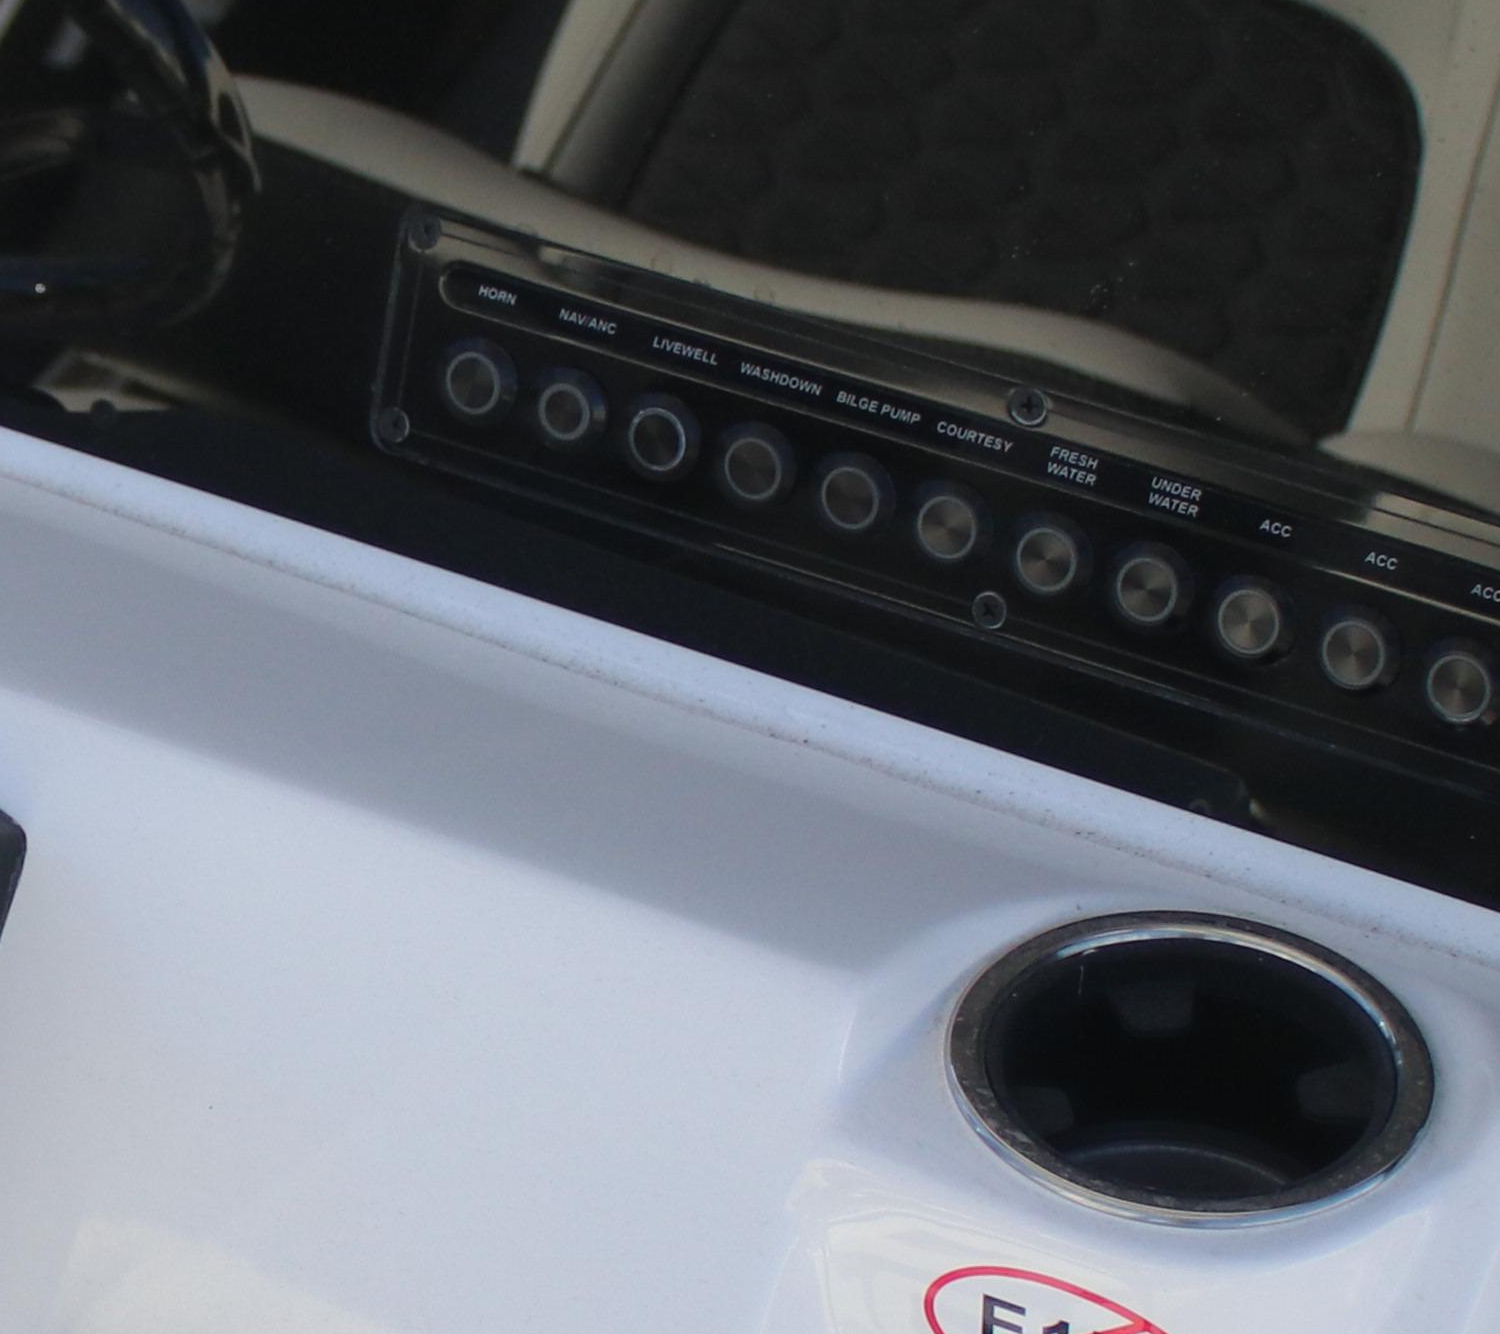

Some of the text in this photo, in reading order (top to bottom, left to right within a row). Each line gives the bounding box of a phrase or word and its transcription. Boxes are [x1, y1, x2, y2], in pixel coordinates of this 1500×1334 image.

[478, 284, 517, 305] HORN
[559, 308, 616, 335] NAV/ANC
[652, 336, 718, 366] LIVEWELL
[740, 361, 822, 396] WASHDOWN
[836, 391, 921, 424] BILGE PUMP
[936, 421, 1014, 454] COURTESY
[1050, 447, 1098, 470] FRESH
[1047, 462, 1097, 487] WATER
[1151, 476, 1202, 501] UNDER
[1148, 493, 1199, 517] WATER
[1259, 518, 1292, 539] ACC
[1364, 551, 1398, 571] ACC
